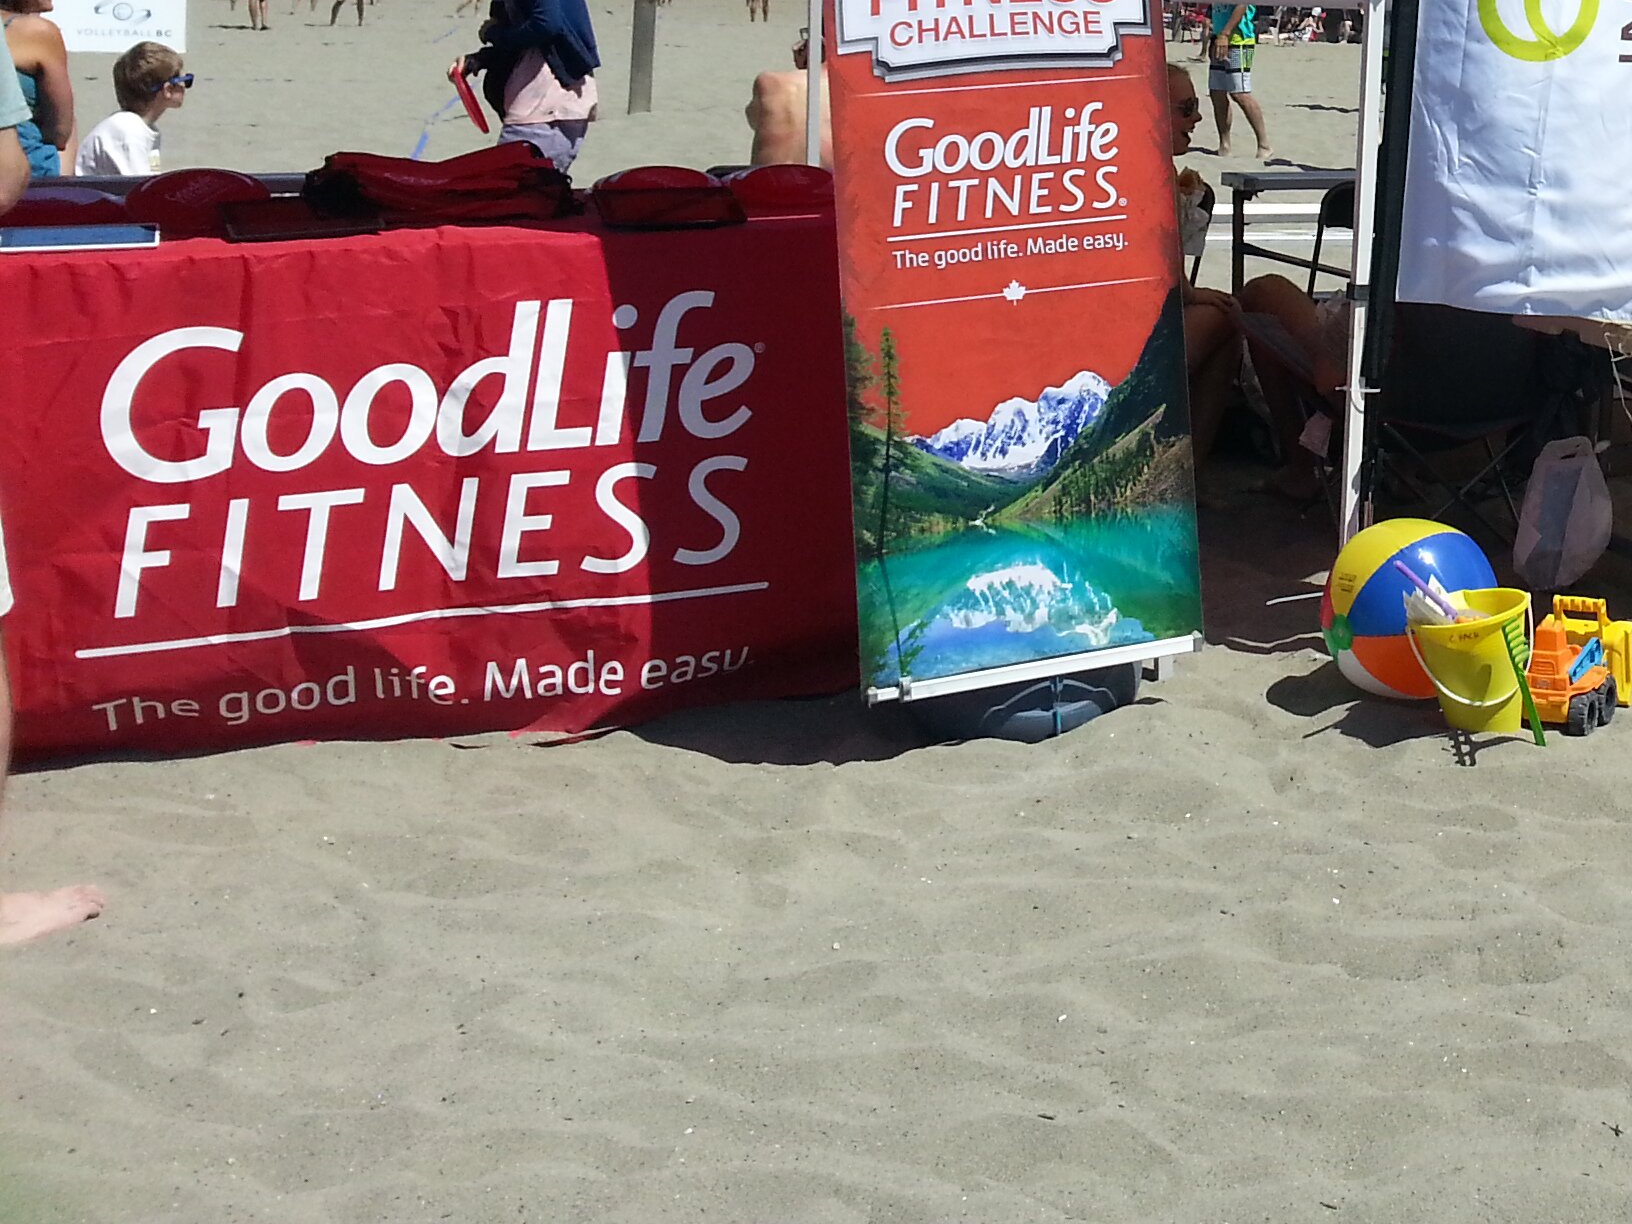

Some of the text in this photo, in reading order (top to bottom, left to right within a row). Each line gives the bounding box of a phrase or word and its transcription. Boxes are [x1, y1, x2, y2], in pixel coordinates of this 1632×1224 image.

[77, 28, 173, 38] VOLLEYBALL BC
[889, 10, 1104, 48] CHALLENGE
[884, 101, 1120, 178] GoodLife
[892, 166, 1119, 227] FITNESS
[892, 233, 1129, 269] The good life. Made easy.
[99, 290, 758, 484] GoodLife
[114, 455, 749, 619] FITNESS
[92, 697, 200, 732] The
[218, 666, 357, 726] good
[374, 665, 470, 705] life.
[483, 649, 625, 702] Made
